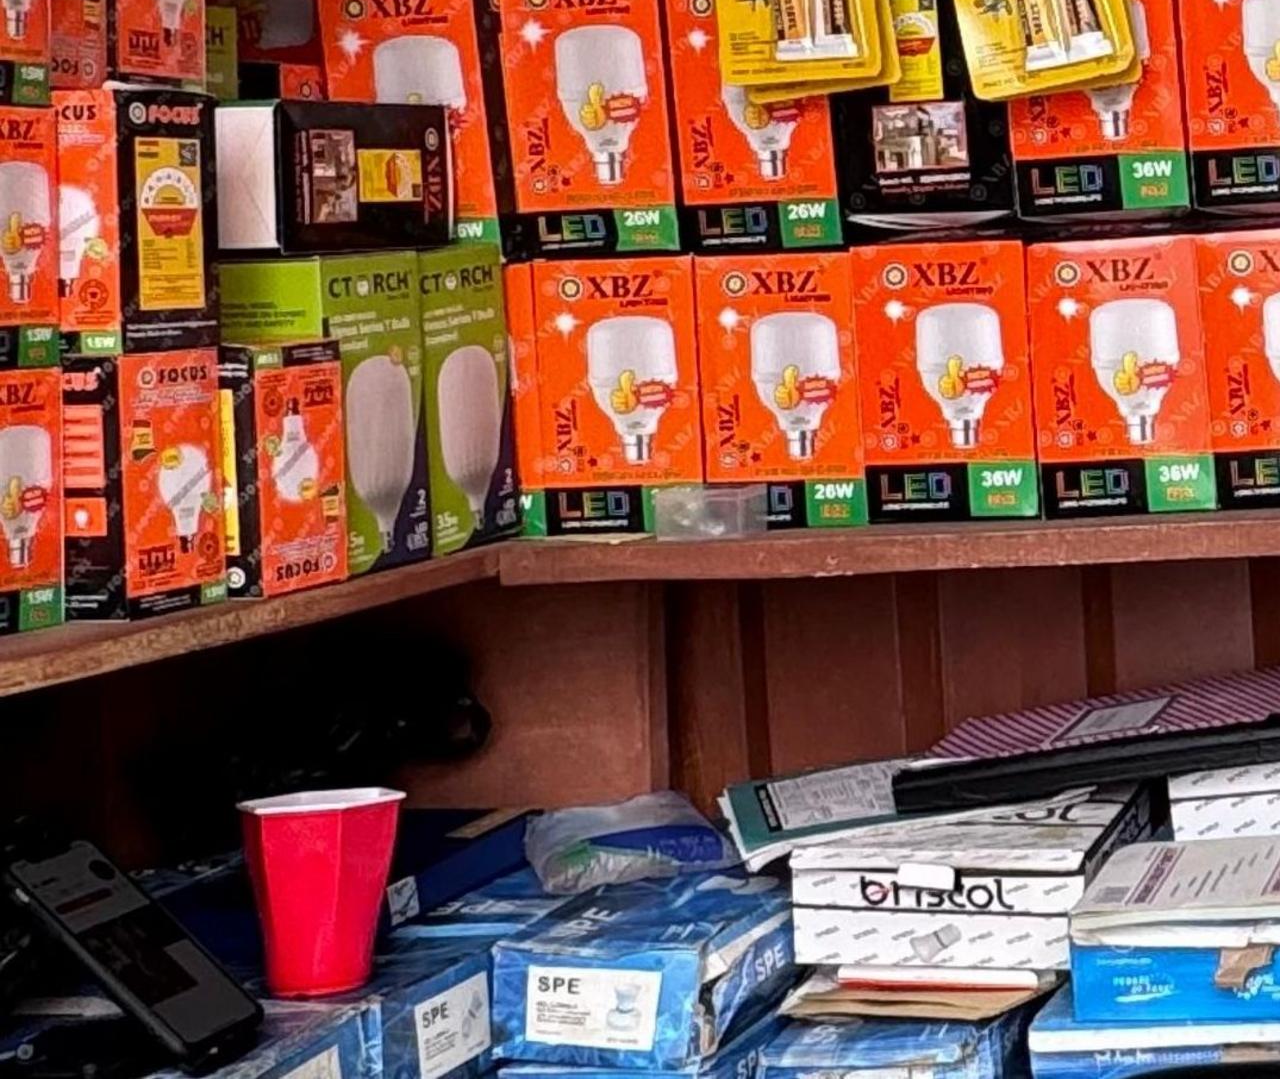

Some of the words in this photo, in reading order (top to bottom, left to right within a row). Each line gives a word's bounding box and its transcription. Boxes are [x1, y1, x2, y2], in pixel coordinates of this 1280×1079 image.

[51, 103, 97, 121] CUS
[1031, 166, 1103, 195] LED
[1132, 159, 1173, 178] 36W
[1209, 154, 1280, 184] LED
[623, 209, 660, 226] 26W
[699, 207, 767, 235] LED
[786, 202, 827, 220] 26W
[458, 221, 484, 239] 6W
[537, 213, 606, 241] LED
[751, 270, 818, 296] XBZ
[912, 262, 981, 288] XBZ
[1085, 257, 1156, 284] XBZ
[586, 274, 653, 300] XBZ
[979, 469, 1023, 488] 36W
[1056, 467, 1131, 498] LED
[1158, 464, 1200, 482] 36W
[813, 482, 855, 500] 26W
[880, 472, 952, 501] LED
[558, 490, 629, 518] LED
[755, 941, 786, 980] SPE
[537, 976, 582, 995] SPE
[422, 1001, 449, 1029] SPE
